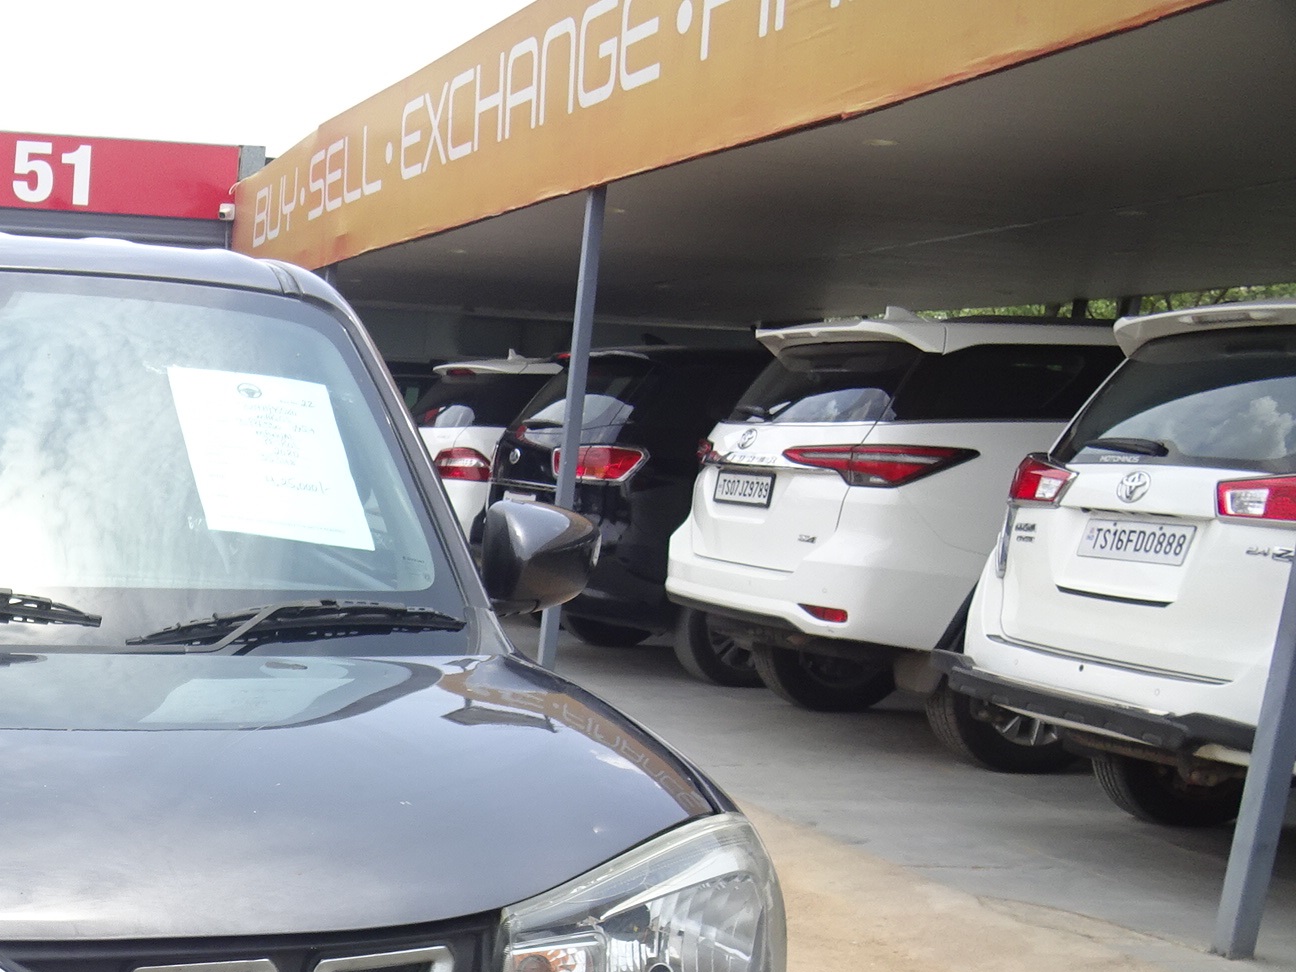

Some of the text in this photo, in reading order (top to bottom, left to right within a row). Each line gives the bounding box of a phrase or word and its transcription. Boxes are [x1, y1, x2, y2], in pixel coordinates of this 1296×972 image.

[252, 166, 299, 248] BUY
[307, 125, 382, 221] SELL
[400, 0, 660, 180] EXCHANGE
[12, 140, 92, 206] 51
[720, 478, 770, 499] TS07JZ9789
[1092, 527, 1187, 556] TS16FD0888
